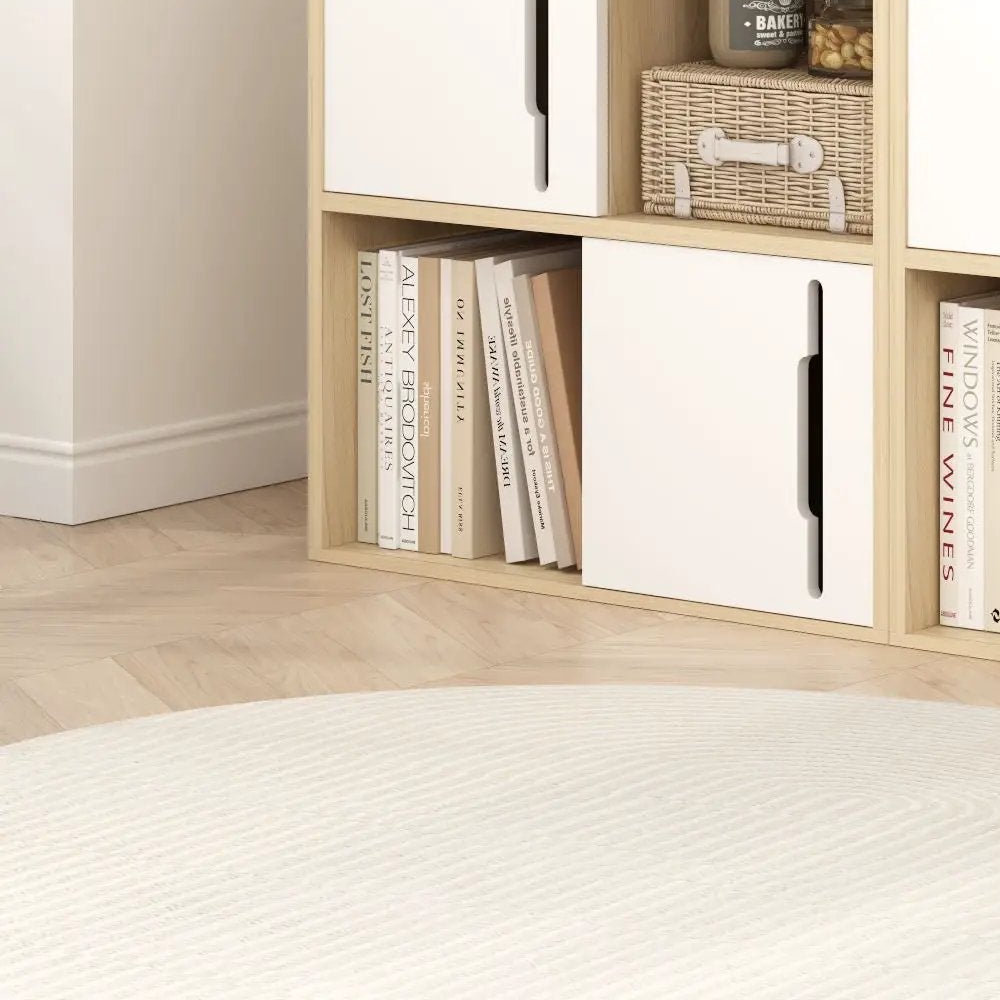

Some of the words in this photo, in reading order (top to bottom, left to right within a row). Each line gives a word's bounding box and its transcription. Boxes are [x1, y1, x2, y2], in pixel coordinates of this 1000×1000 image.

[756, 31, 777, 39] sweet
[359, 260, 373, 324] LOST
[401, 265, 415, 362] ALEXEY
[359, 330, 373, 384] FISH
[382, 326, 393, 472] ANTIQUAIRES
[942, 348, 954, 433] FINE
[962, 319, 978, 448] WINDOWS
[401, 369, 416, 531] BRODOVITCH
[966, 462, 975, 514] BERGDORF
[942, 453, 954, 582] WINES
[966, 516, 975, 570] GOODMAN
